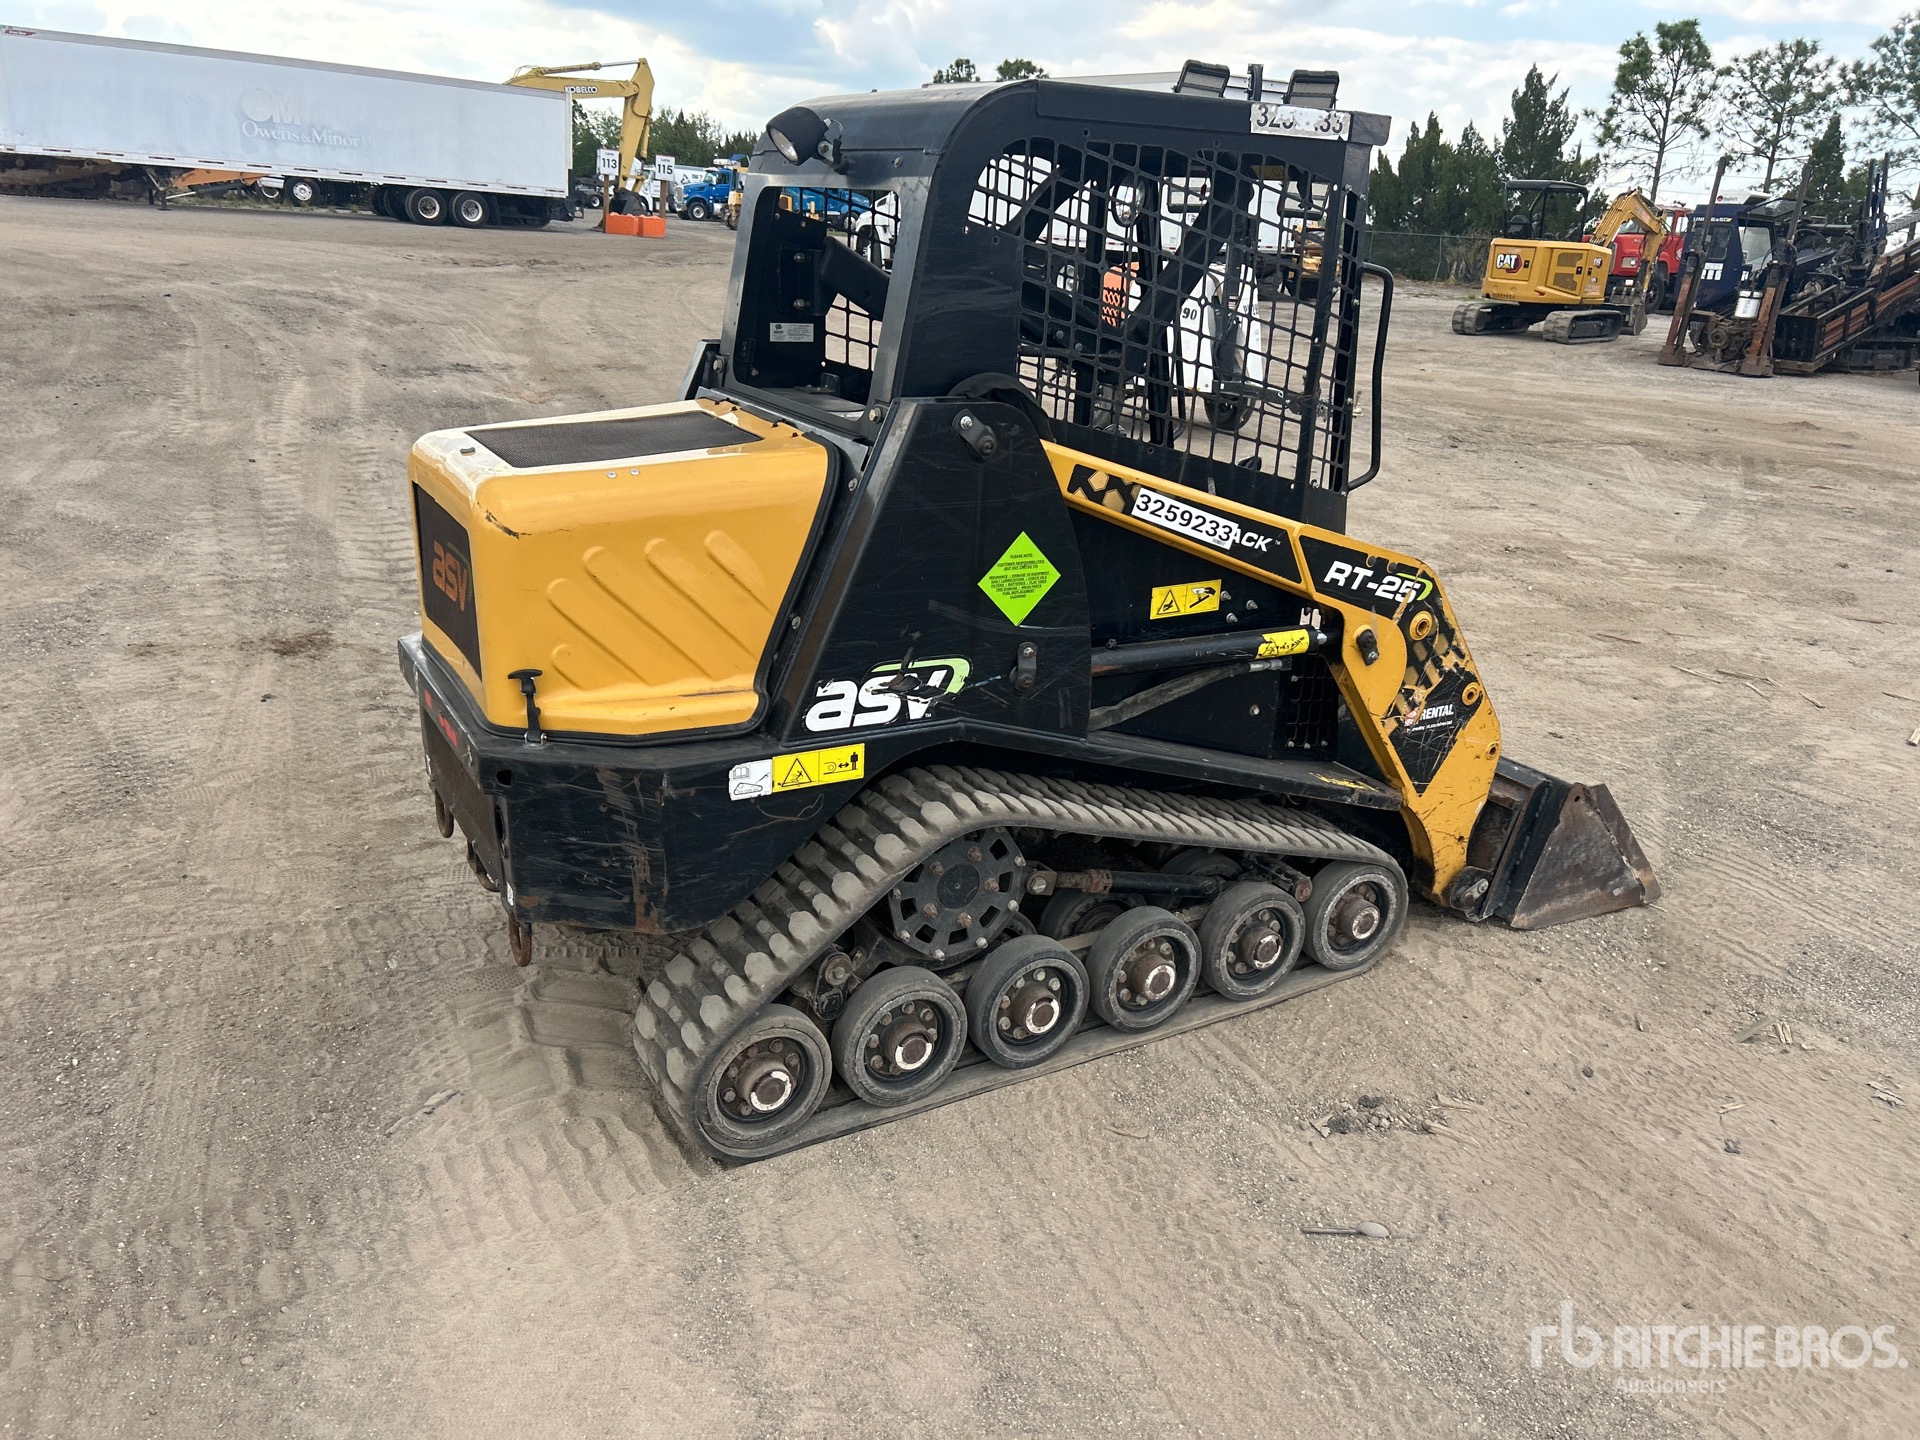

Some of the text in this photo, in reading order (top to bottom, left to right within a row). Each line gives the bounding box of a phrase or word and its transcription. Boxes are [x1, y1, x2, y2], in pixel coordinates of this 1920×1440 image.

[564, 85, 598, 94] KOBELCO
[242, 120, 300, 141] Owens
[602, 158, 617, 169] 113
[657, 164, 673, 175] 115
[1496, 253, 1518, 270] CAT
[1181, 307, 1198, 320] 90
[1136, 493, 1233, 542] 3259233
[1324, 560, 1421, 604] RT-25
[1420, 704, 1454, 720] RENTAL
